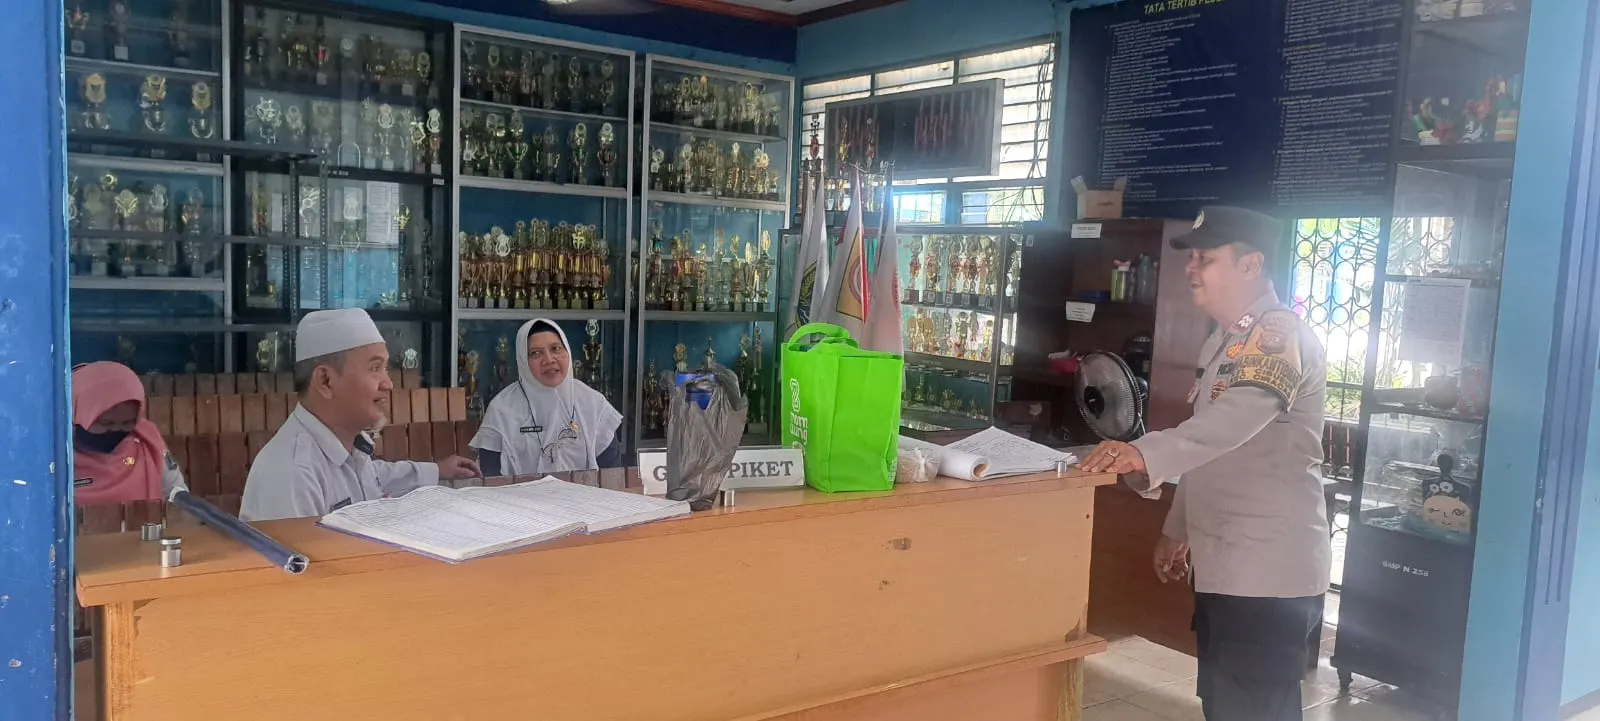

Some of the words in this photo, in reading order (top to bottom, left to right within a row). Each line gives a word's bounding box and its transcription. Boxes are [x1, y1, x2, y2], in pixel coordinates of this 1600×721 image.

[1144, 2, 1165, 15] TATA
[1167, 0, 1197, 10] TERTIB
[728, 461, 794, 478] PIKET
[1403, 565, 1410, 573] N
